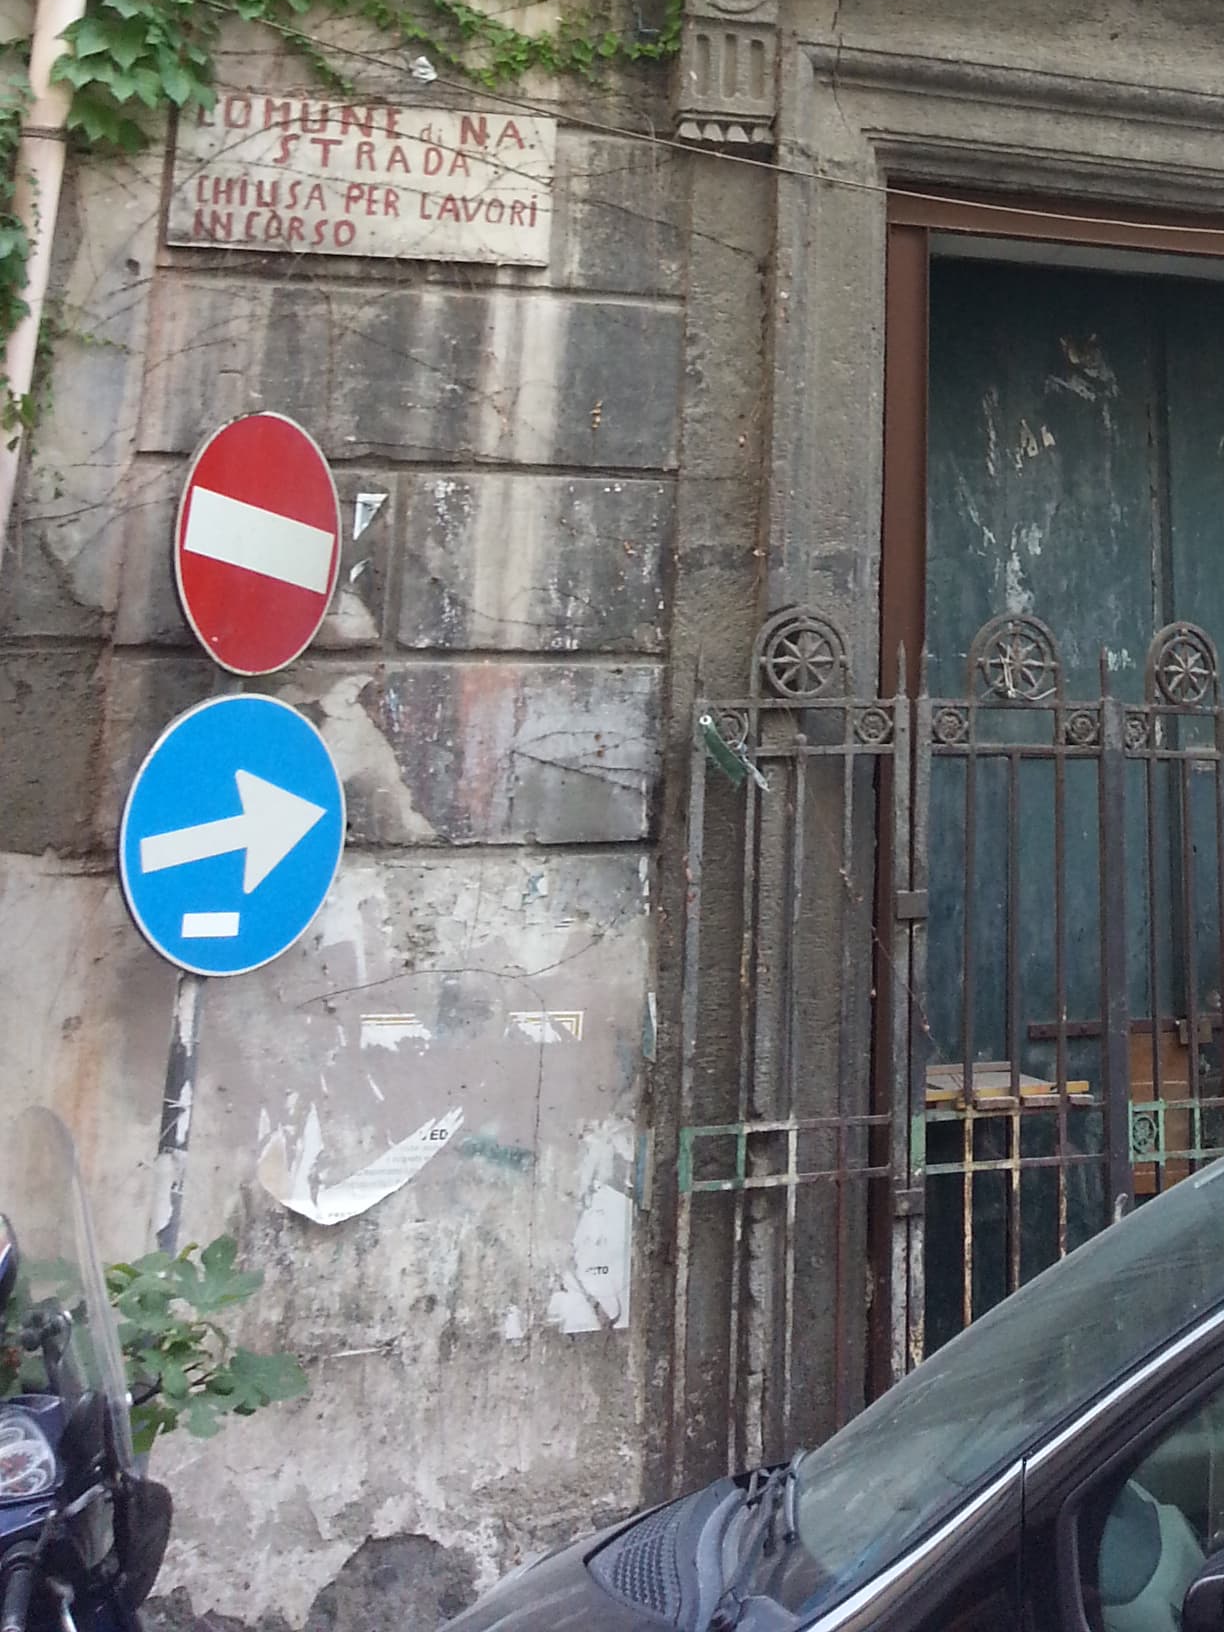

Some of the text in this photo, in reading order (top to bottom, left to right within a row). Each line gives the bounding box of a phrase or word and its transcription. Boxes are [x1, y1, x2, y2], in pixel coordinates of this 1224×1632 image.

[272, 133, 470, 177] STRADA
[345, 183, 399, 218] PER
[246, 210, 356, 248] CORSO
